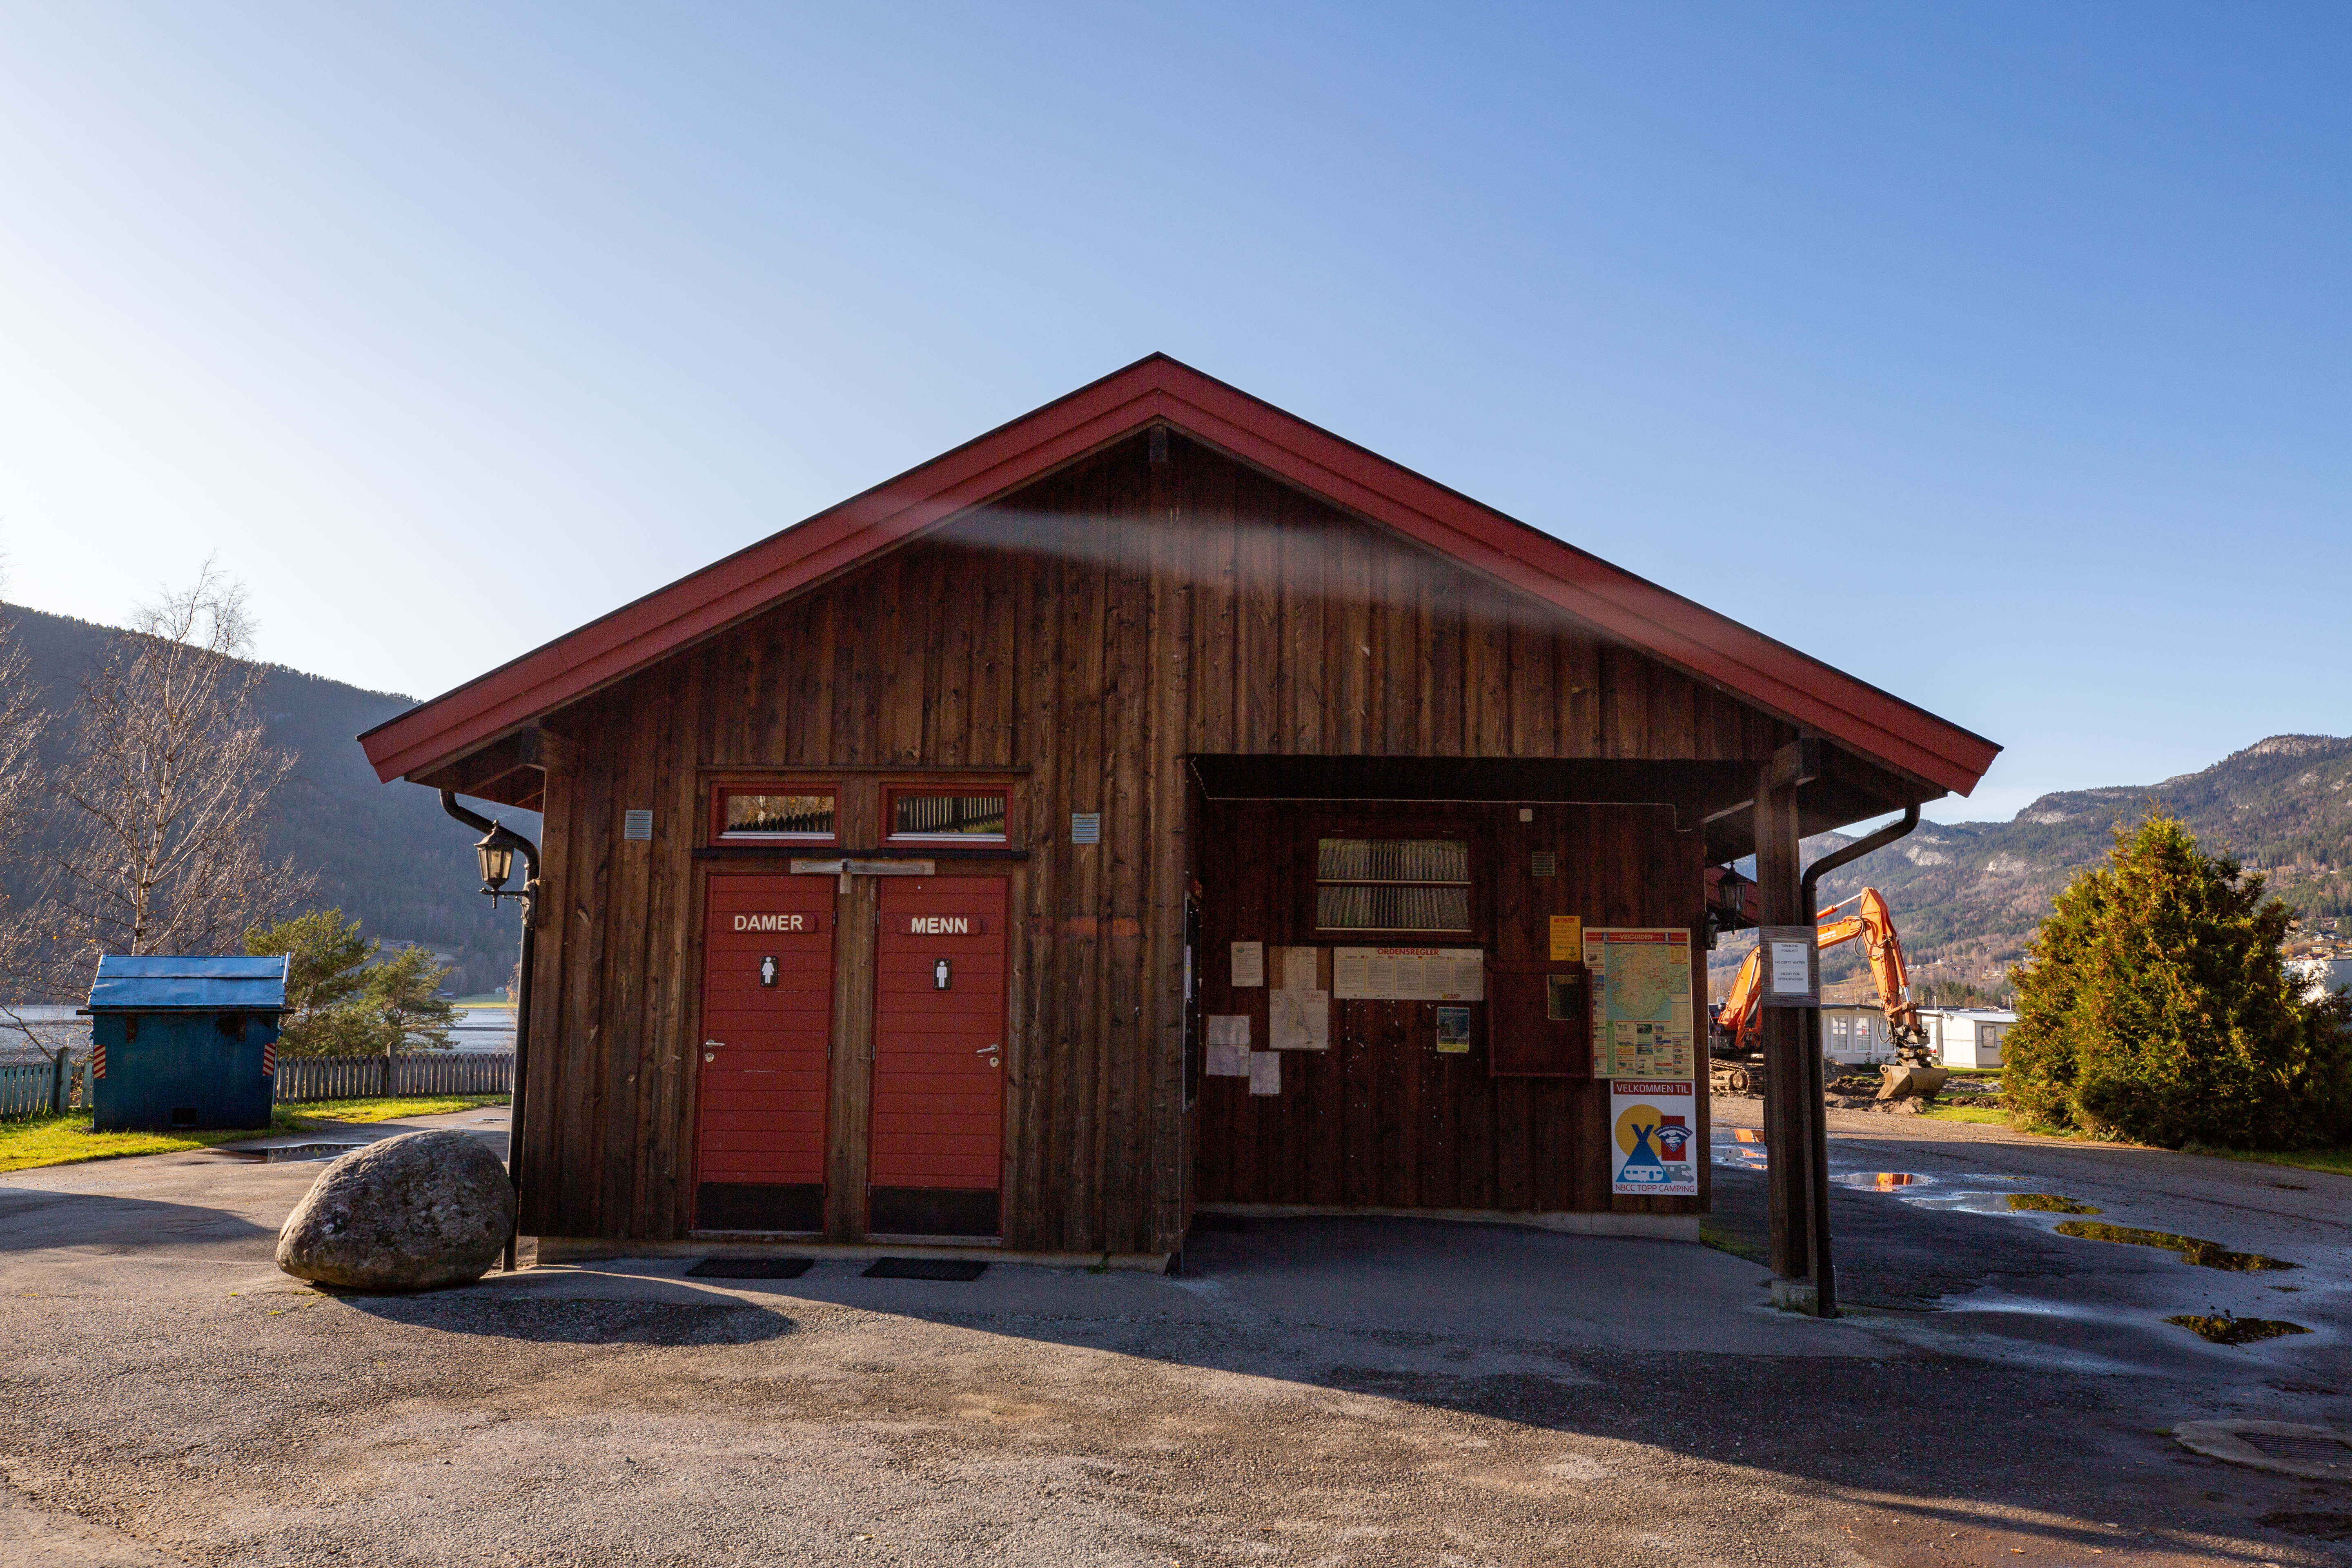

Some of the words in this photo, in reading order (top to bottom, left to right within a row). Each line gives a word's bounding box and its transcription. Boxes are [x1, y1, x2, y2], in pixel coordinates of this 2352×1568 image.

[734, 915, 803, 931] DAMER
[911, 917, 968, 933] MENN
[1616, 1084, 1673, 1093] VELKOMMEN
[1675, 1085, 1689, 1093] TIL
